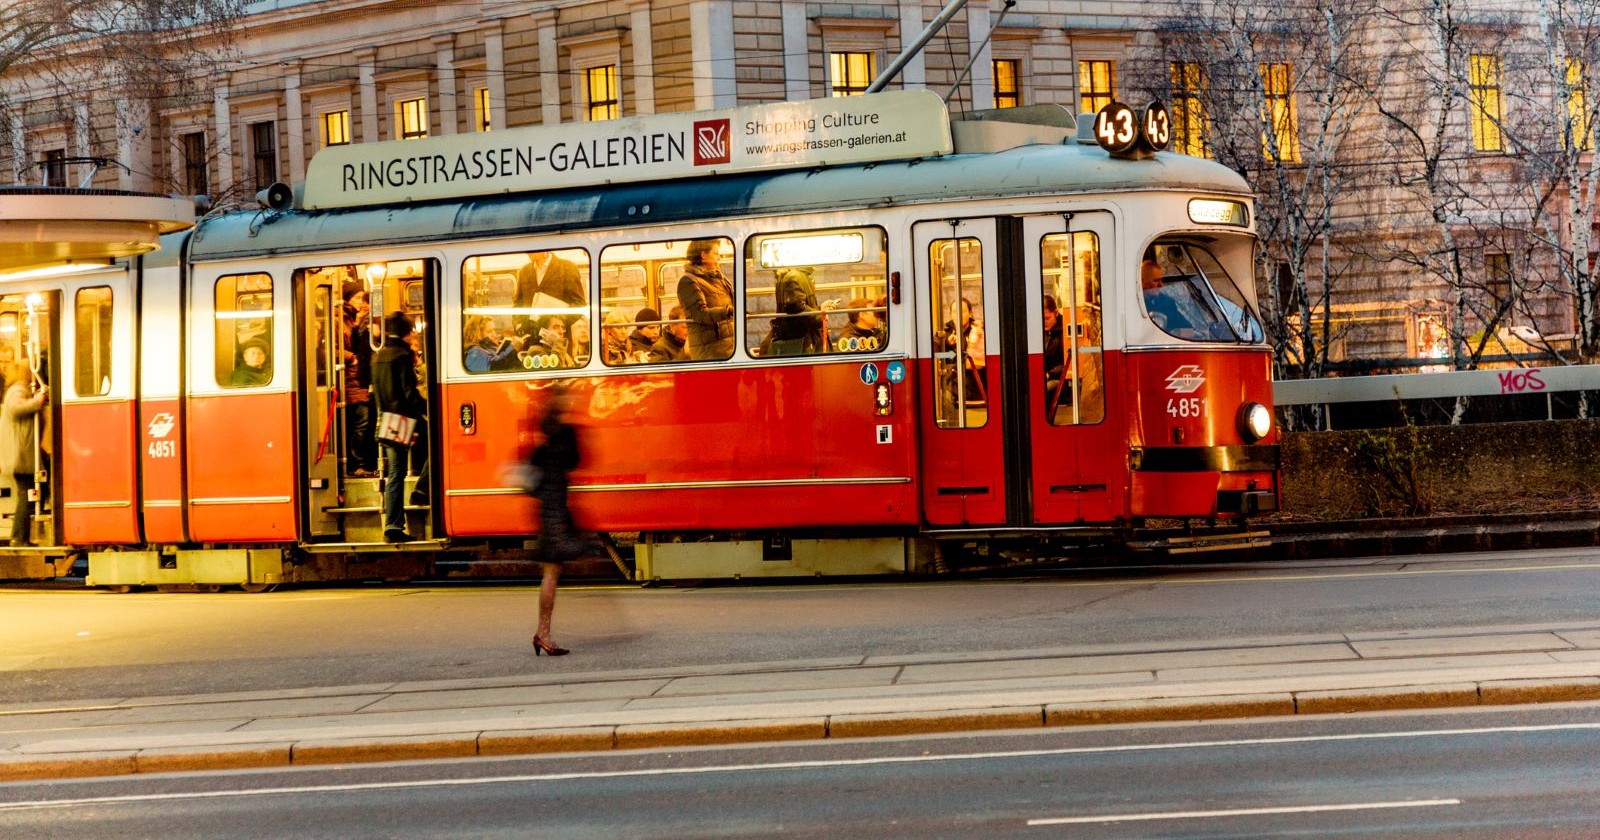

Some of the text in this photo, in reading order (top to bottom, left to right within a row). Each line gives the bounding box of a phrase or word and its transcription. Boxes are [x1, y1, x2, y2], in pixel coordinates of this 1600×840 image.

[745, 112, 880, 136] Shopping Culture
[1099, 108, 1133, 145] 43
[1147, 108, 1170, 144] 43
[745, 131, 907, 156] www.ringstrassen-galerien.at
[342, 131, 686, 192] RINGSTRASSEN-GALERIEN
[1498, 369, 1546, 394] MOS
[1166, 397, 1209, 418] 4851
[148, 440, 176, 458] 4851
